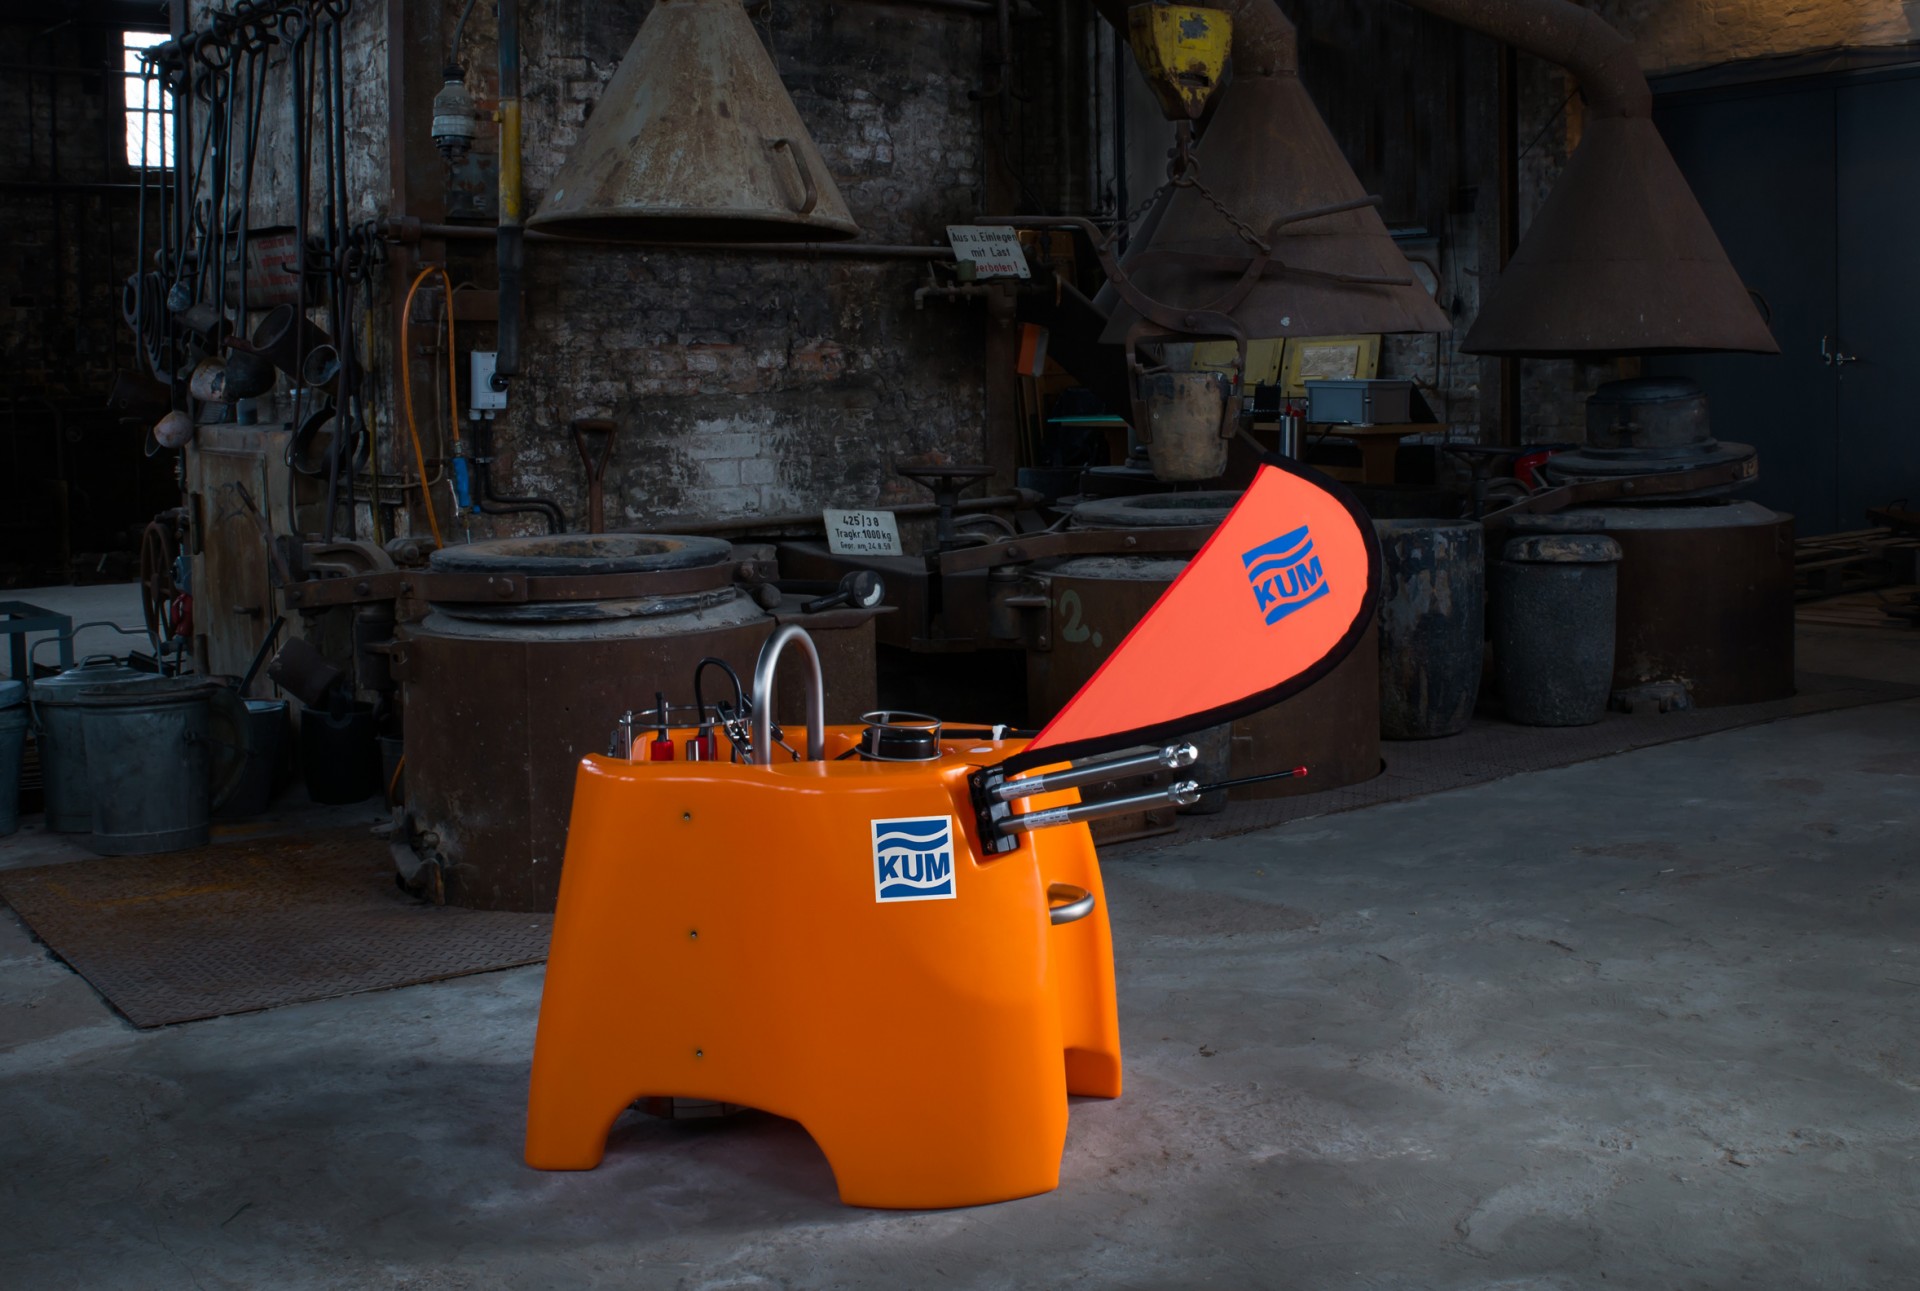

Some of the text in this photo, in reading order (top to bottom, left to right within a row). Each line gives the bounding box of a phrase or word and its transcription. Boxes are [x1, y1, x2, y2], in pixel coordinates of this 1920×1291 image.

[952, 232, 969, 242] Aus
[979, 232, 1018, 244] Einlegen
[971, 247, 1011, 257] mit Last
[863, 529, 881, 540] 1000
[881, 530, 892, 542] kg
[1253, 555, 1323, 613] KUM
[1059, 589, 1103, 648] 2.
[878, 852, 950, 884] KUM
